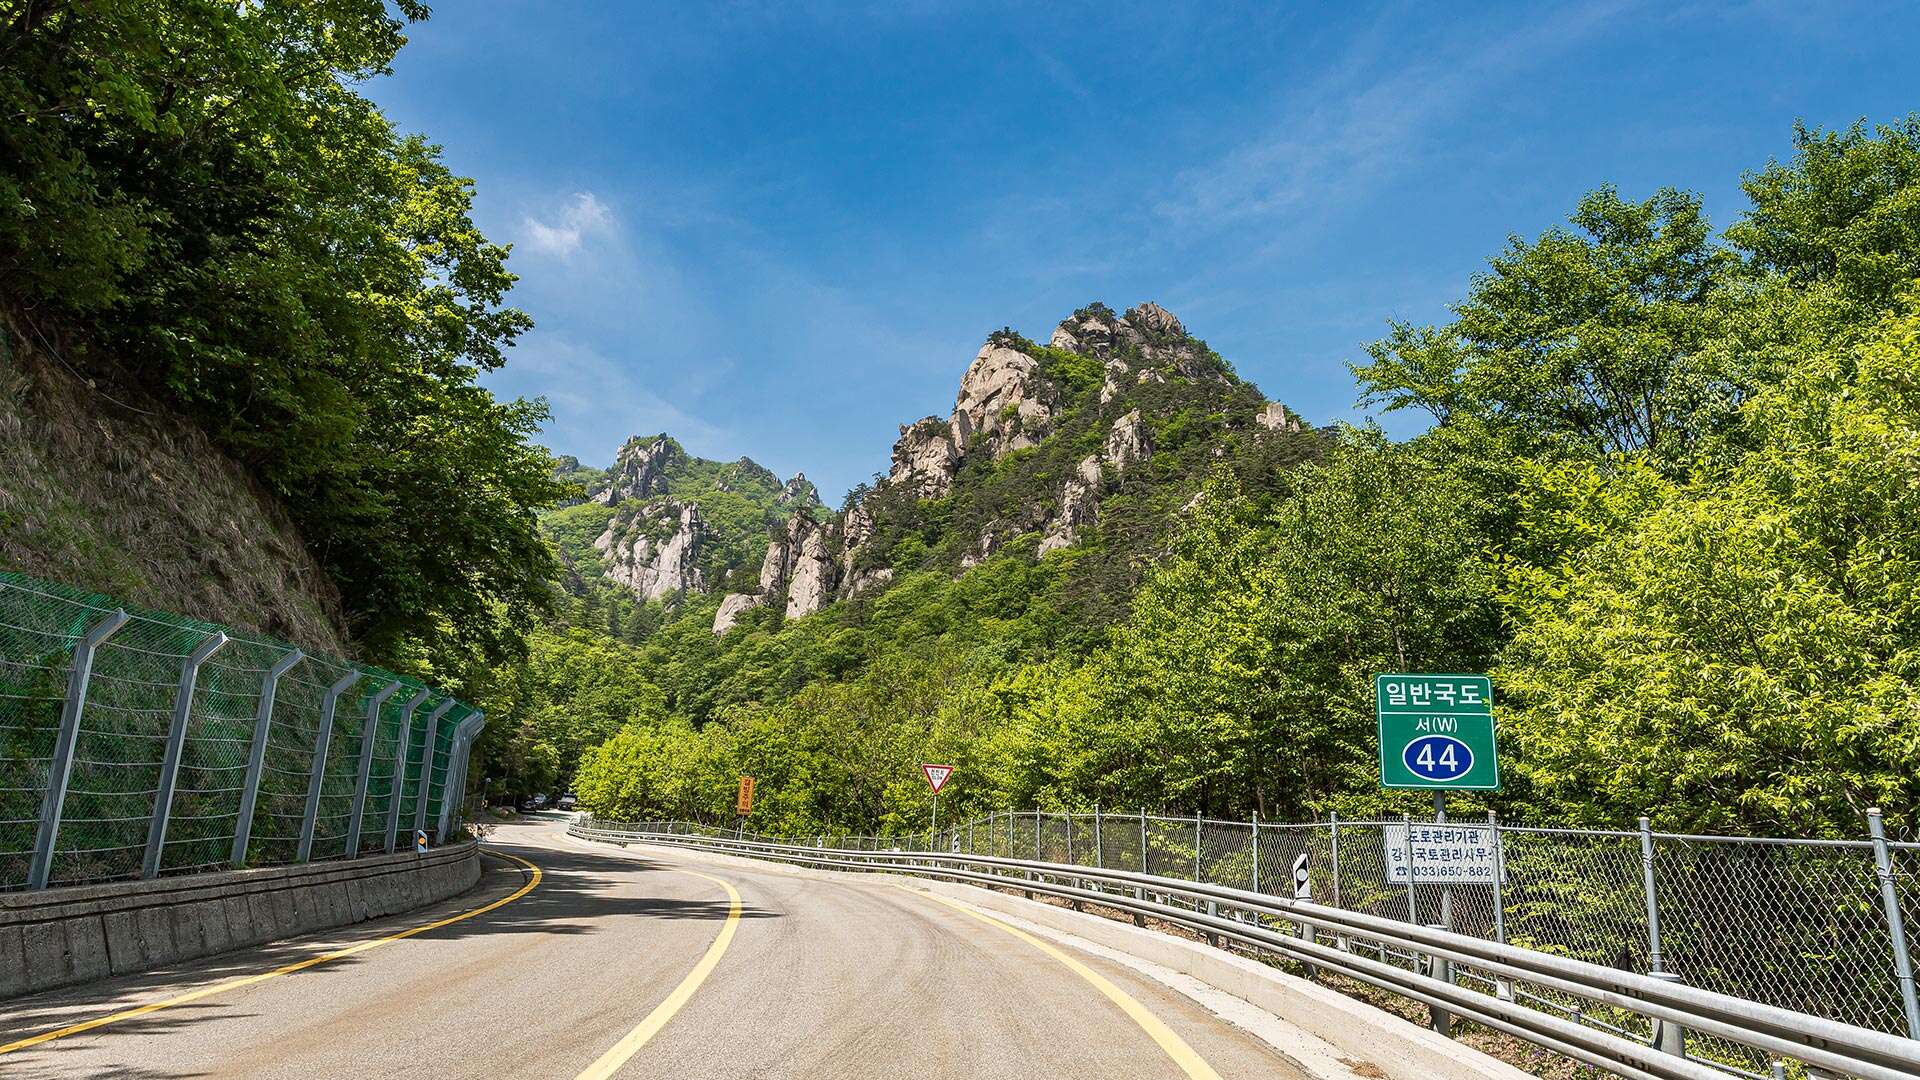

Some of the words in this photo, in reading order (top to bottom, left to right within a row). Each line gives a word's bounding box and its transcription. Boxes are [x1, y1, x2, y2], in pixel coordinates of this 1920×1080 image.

[1386, 682, 1482, 706] 일반국도
[1415, 717, 1458, 733] 서(W)
[1416, 743, 1459, 772] 44
[1409, 830, 1479, 843] 도로관리기관
[1391, 847, 1492, 861] 강국토관리사무
